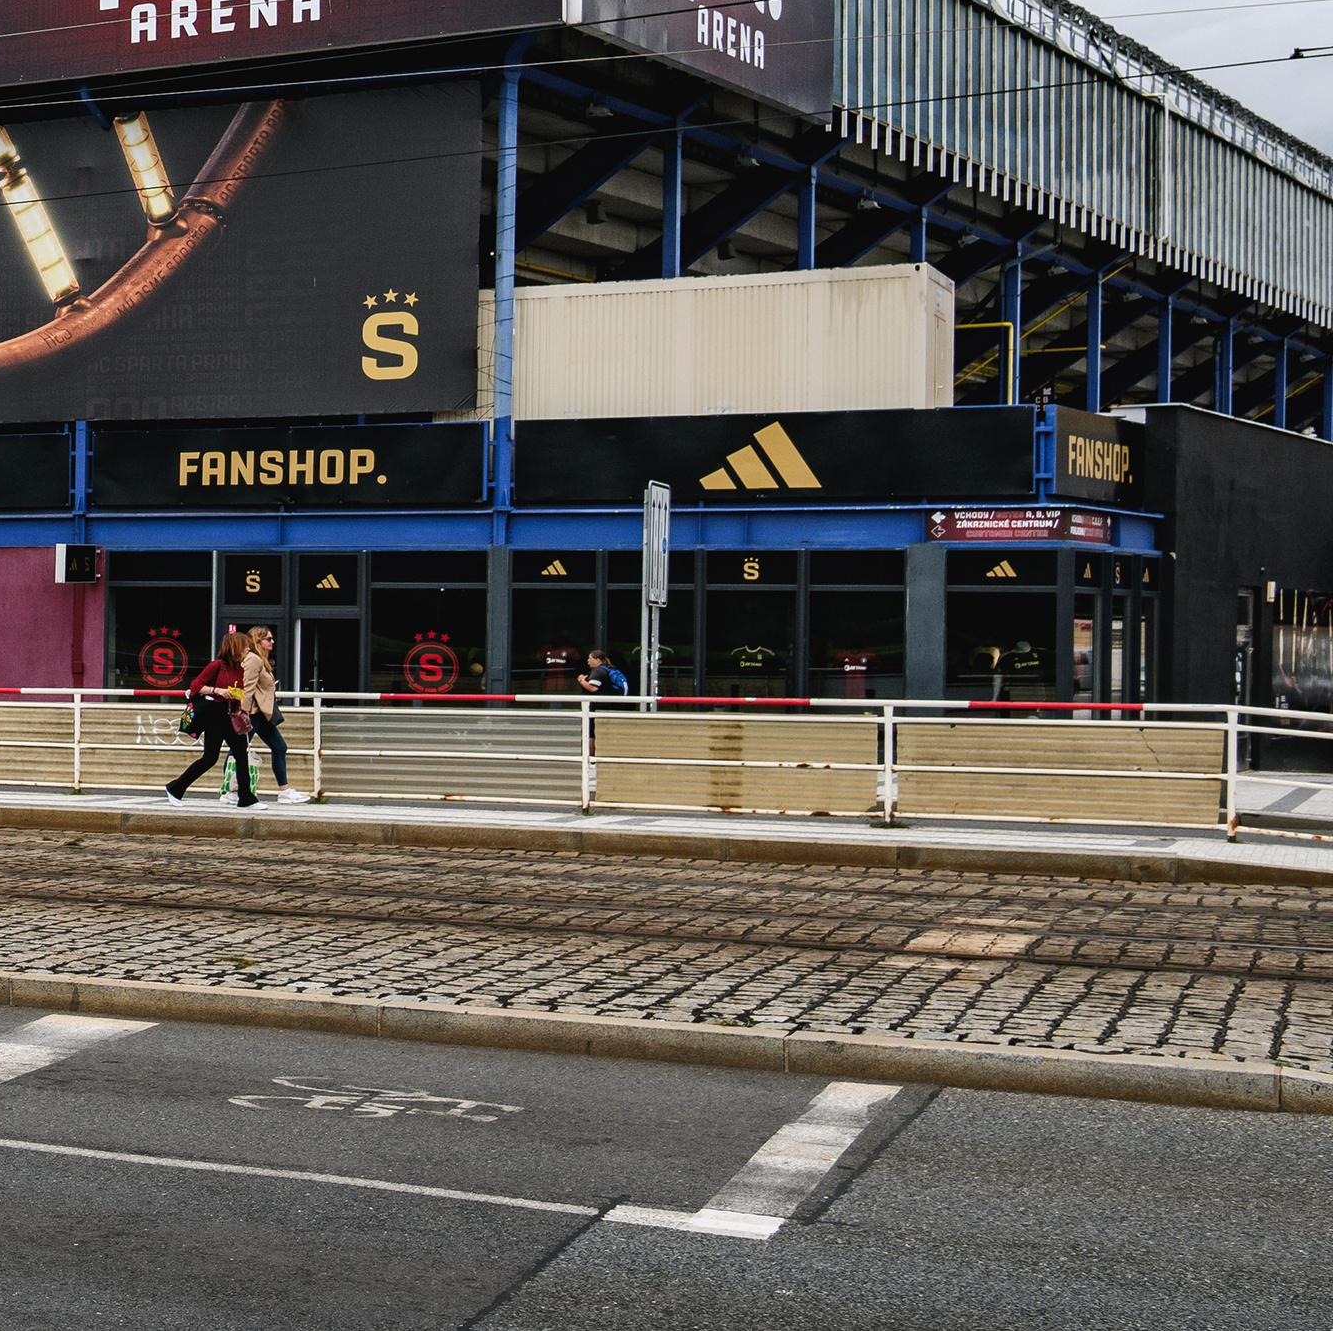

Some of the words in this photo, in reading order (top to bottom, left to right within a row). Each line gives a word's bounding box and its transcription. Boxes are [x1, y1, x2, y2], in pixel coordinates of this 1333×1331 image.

[696, 5, 765, 70] ARENA
[362, 312, 419, 381] S
[179, 449, 388, 487] FANSHOP.
[1068, 434, 1133, 484] FANSHOP.
[956, 519, 1010, 529] ZÁKAZNICKÉ
[1011, 519, 1053, 528] CENTRUM
[1045, 510, 1061, 518] VIP
[152, 647, 174, 675] S
[419, 653, 444, 682] S
